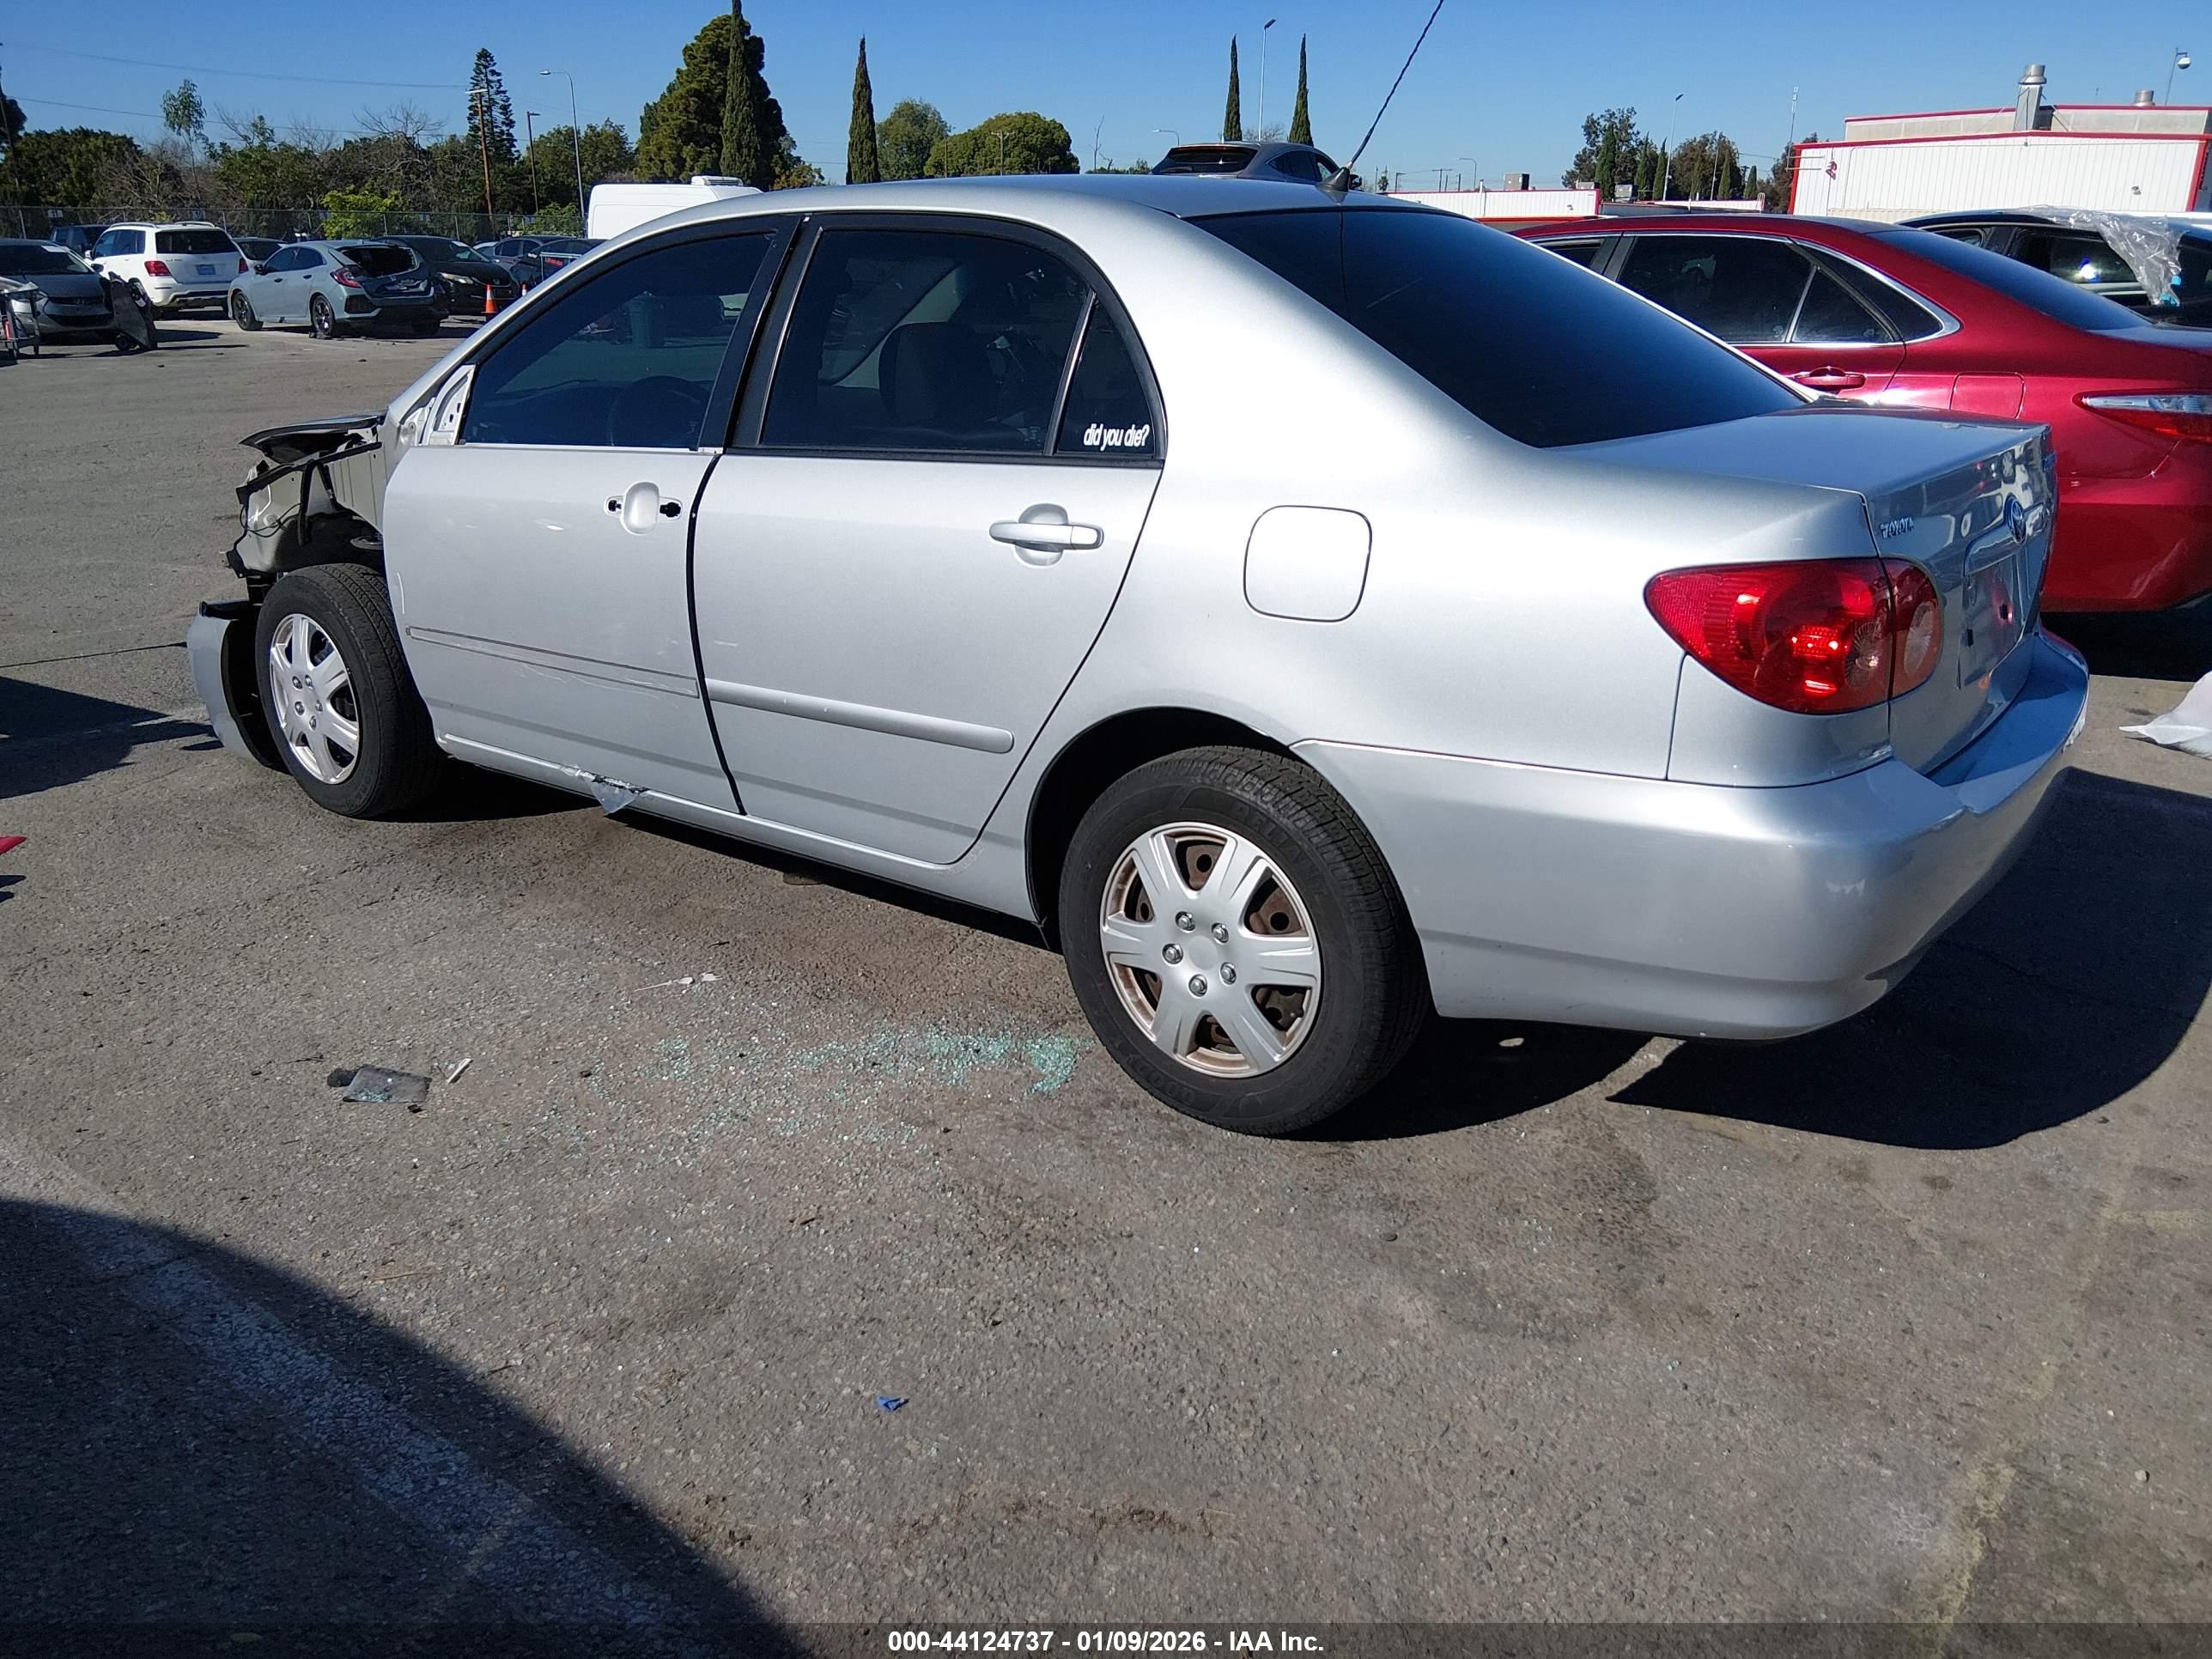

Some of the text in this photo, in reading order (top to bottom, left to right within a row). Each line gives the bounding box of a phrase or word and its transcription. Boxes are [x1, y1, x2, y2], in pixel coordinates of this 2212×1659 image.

[1084, 423, 1150, 452] did you die?
[1881, 516, 1914, 539] TOYOTA
